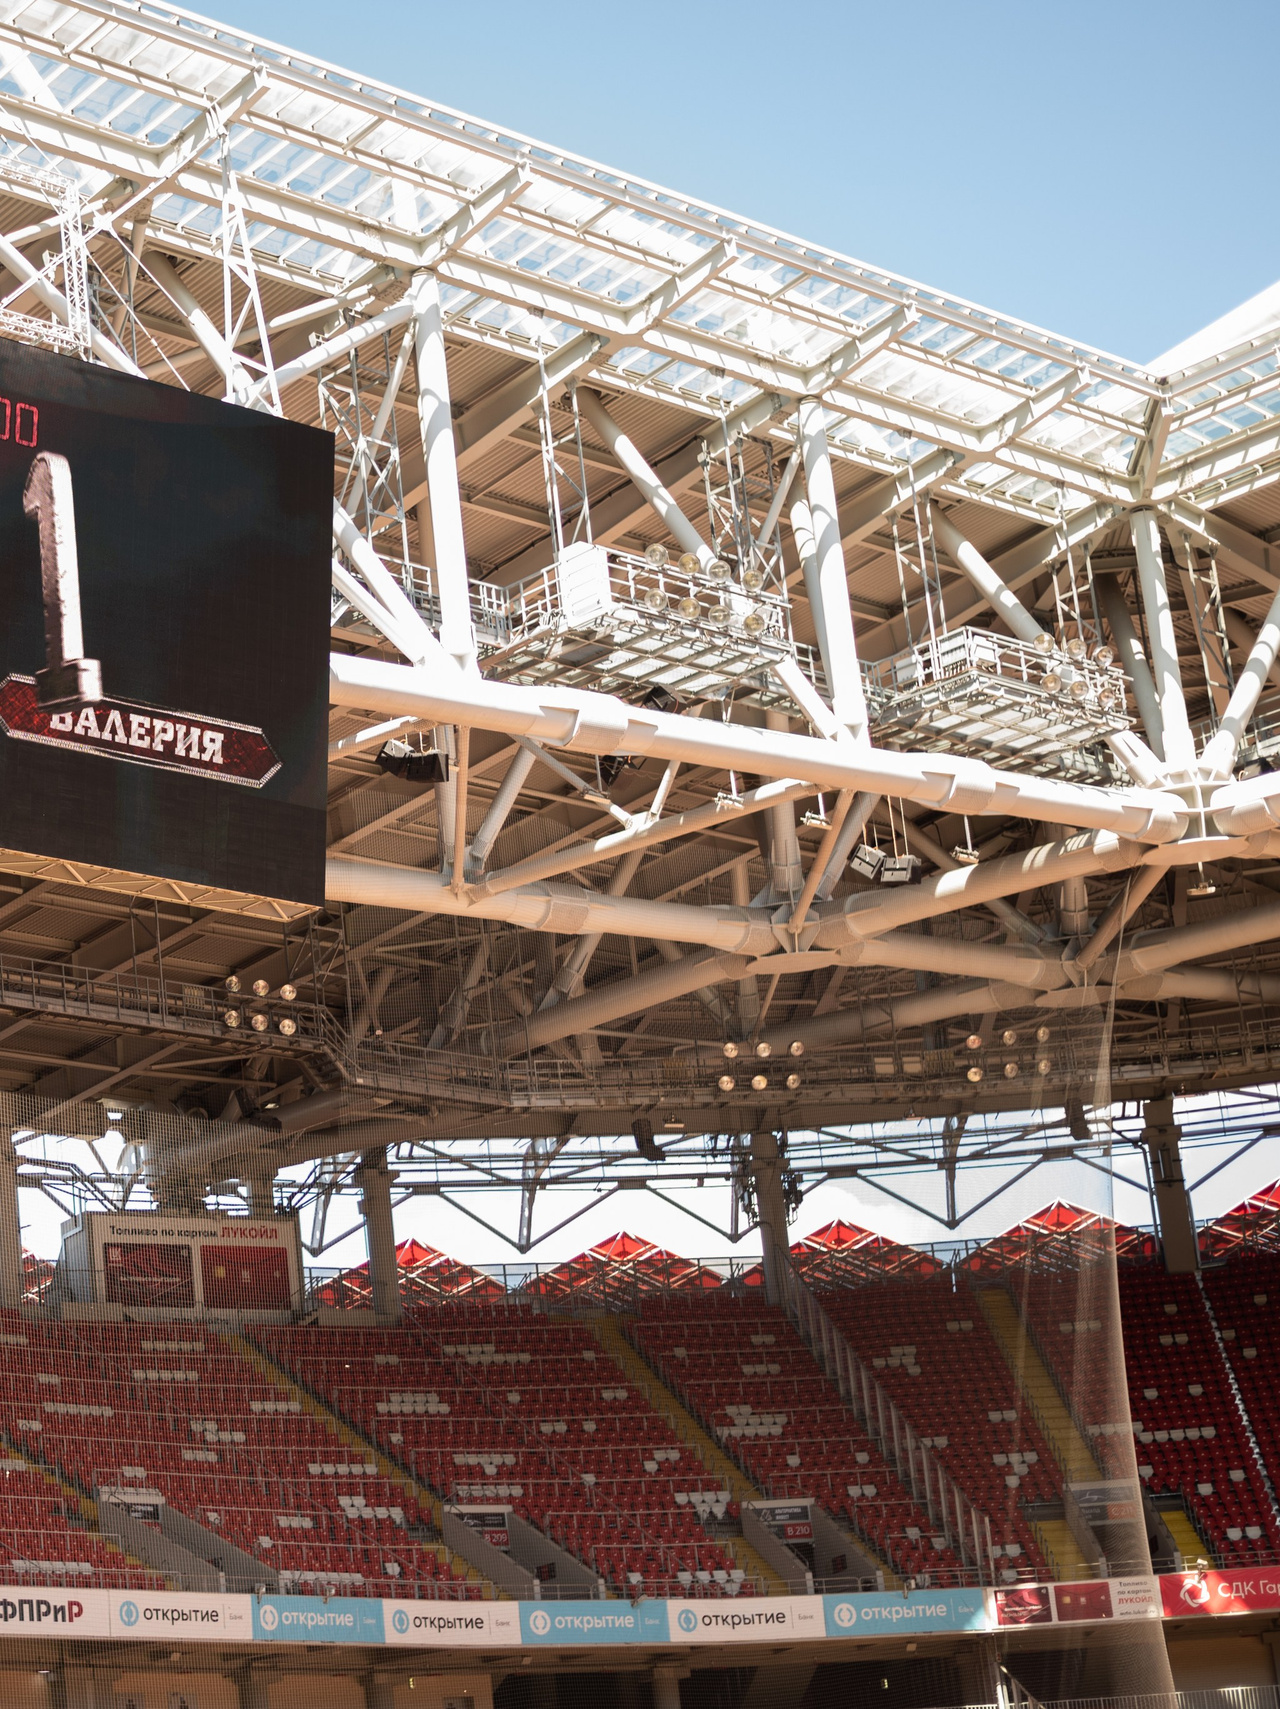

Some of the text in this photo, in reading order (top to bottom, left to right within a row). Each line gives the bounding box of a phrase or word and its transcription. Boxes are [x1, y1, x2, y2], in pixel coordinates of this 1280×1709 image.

[109, 1225, 278, 1240] Топливо по картам ЛУКОЙЛ
[491, 1533, 507, 1542] 209
[795, 1526, 810, 1535] 210
[1217, 1581, 1256, 1600] СДК
[1118, 1595, 1154, 1605] ЛУКОЙЛ
[143, 1607, 219, 1625] открытие
[281, 1609, 354, 1629] открытие
[701, 1611, 786, 1630] открытие
[861, 1603, 975, 1622] открытие Банк
[413, 1615, 484, 1632] открытие
[554, 1612, 635, 1632] открытие
